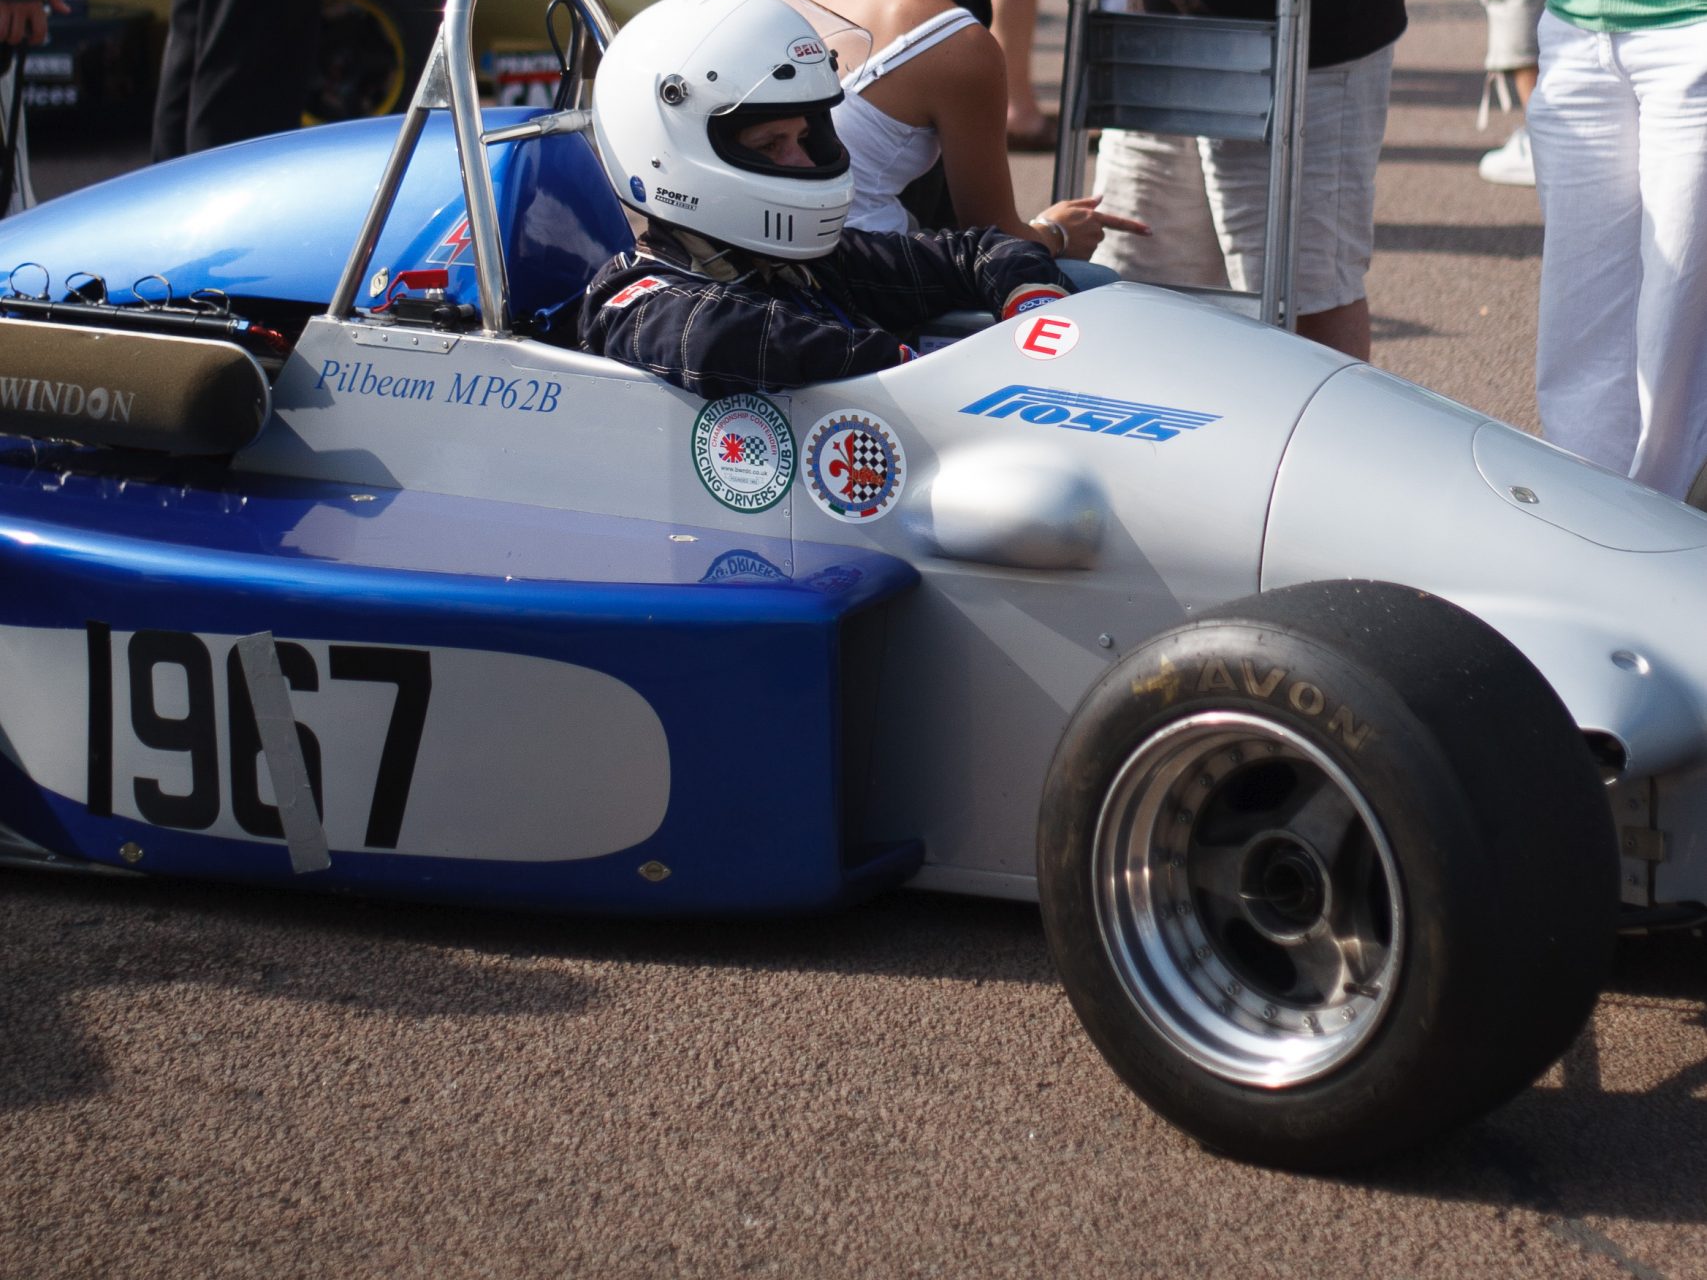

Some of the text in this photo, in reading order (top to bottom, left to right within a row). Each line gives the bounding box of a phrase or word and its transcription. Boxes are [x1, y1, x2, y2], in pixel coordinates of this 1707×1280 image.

[793, 42, 823, 57] BELL
[656, 187, 700, 205] SPORT II
[1023, 318, 1071, 355] E
[314, 359, 562, 413] Pilbeam MP62B
[700, 395, 741, 434] BRITISH
[711, 412, 777, 456] CHAMPIONSHIP CONTENDER
[745, 395, 790, 444] WOMEN
[697, 435, 723, 492] RACING
[775, 448, 792, 487] CLUB
[725, 486, 777, 507] DRIVERS
[1197, 657, 1373, 753] AVON
[87, 619, 432, 849] 1967
